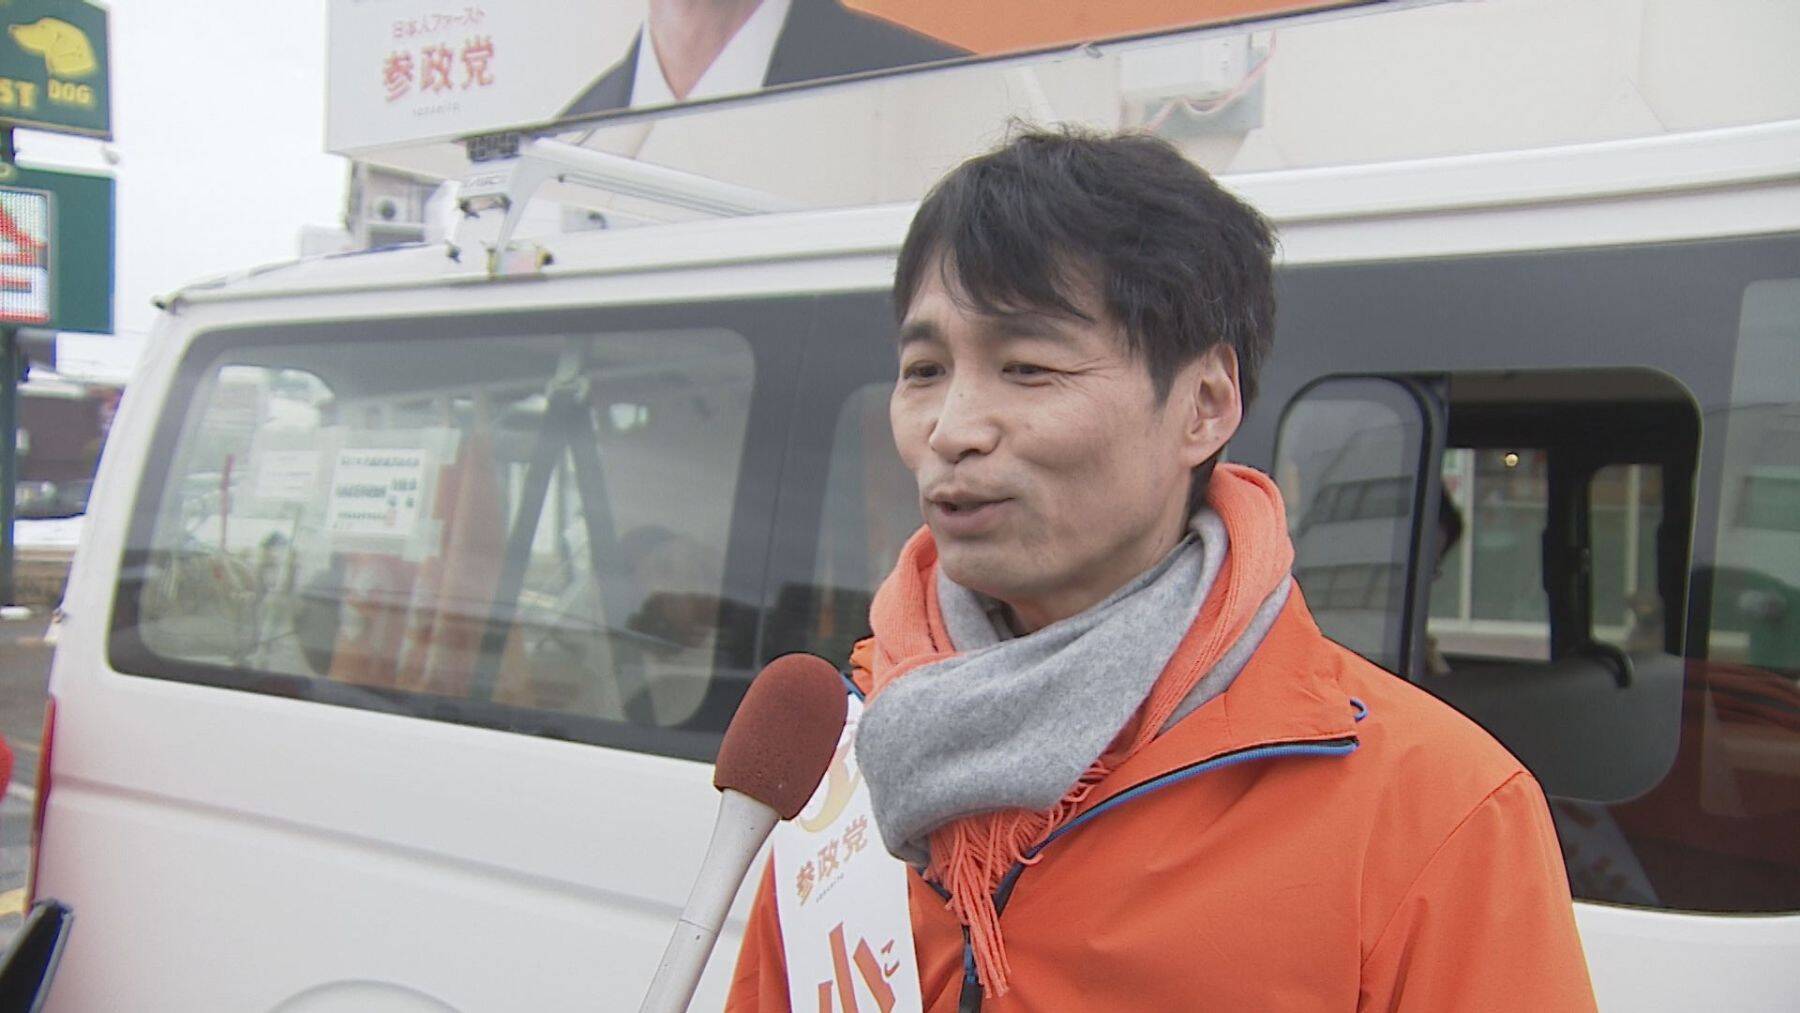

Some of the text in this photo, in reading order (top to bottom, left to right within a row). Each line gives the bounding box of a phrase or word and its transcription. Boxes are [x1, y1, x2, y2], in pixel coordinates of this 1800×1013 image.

[393, 8, 486, 39] 日本人ファースト
[48, 79, 93, 105] DOG
[383, 35, 495, 101] 参政党
[796, 815, 868, 906] 参政党
